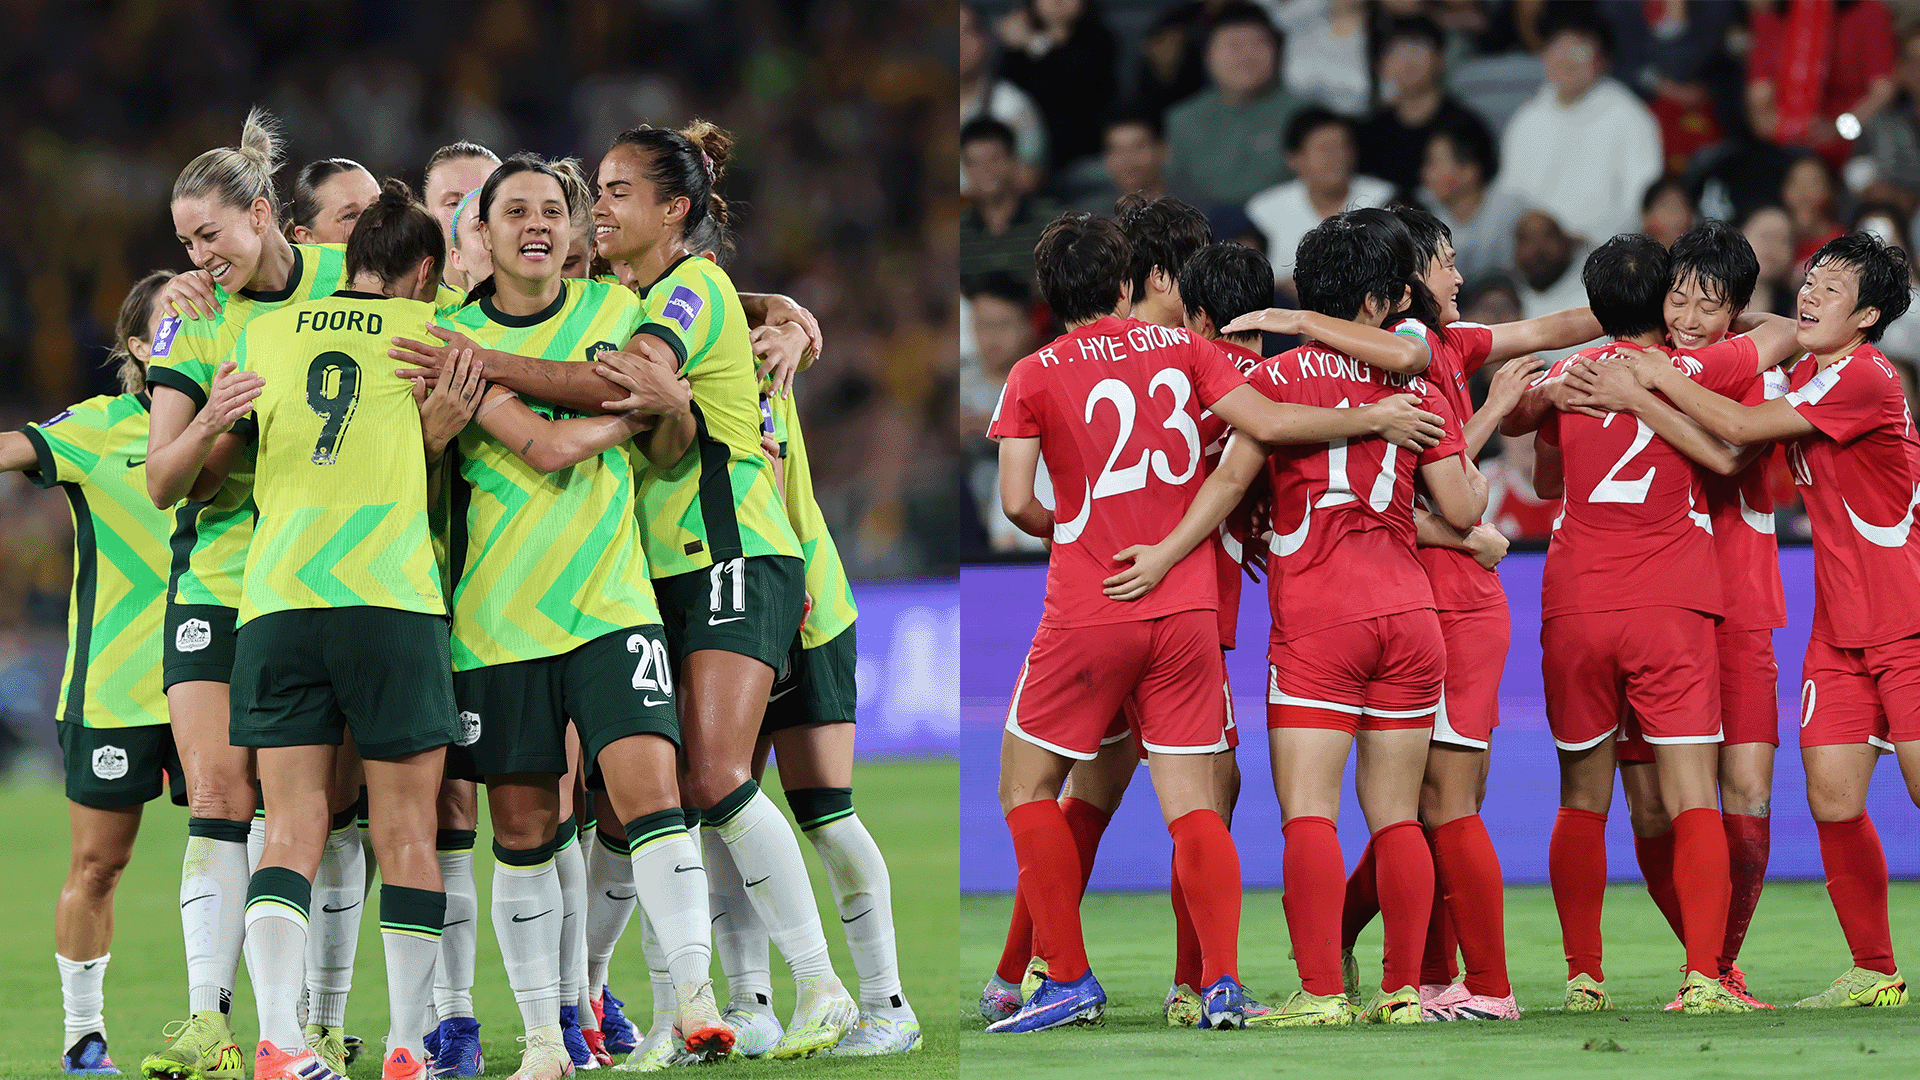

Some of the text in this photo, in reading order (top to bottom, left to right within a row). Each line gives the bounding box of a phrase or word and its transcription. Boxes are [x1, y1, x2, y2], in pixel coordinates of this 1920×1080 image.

[295, 310, 383, 335] FOORD
[1076, 334, 1128, 362] HYE
[1126, 324, 1191, 353] GYONG
[306, 350, 362, 465] 9
[1084, 367, 1201, 500] 23
[1313, 397, 1399, 513] 17
[1587, 412, 1656, 504] 2
[709, 557, 745, 612] 11
[626, 633, 673, 698] 20
